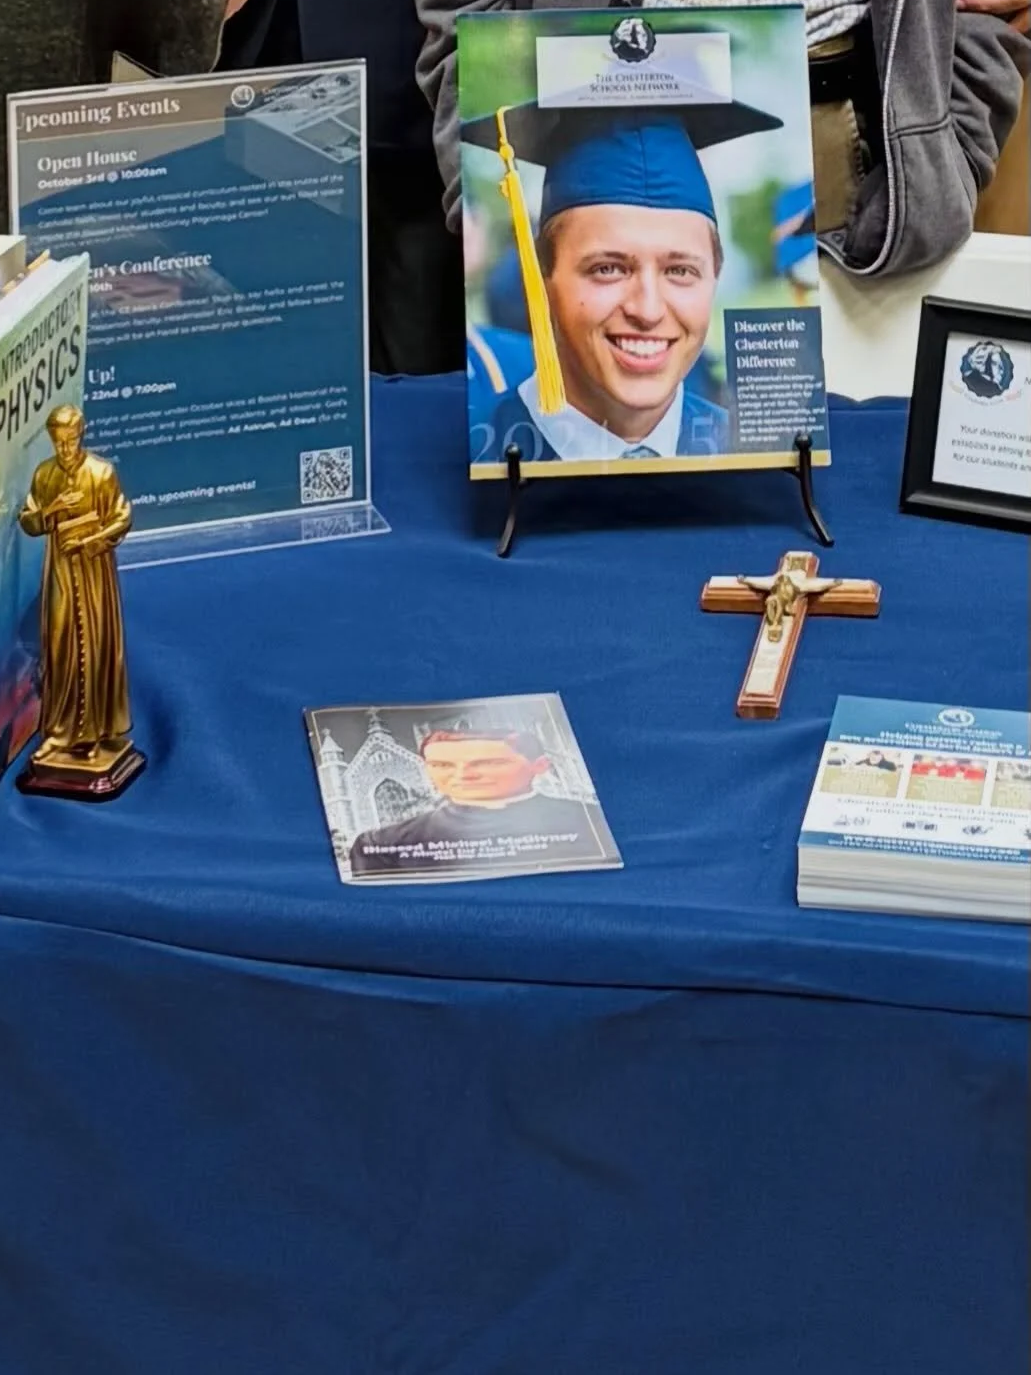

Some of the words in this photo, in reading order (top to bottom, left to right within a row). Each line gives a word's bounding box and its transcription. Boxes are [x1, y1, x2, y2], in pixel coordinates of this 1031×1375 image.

[117, 98, 181, 119] Events
[37, 156, 82, 173] Open
[86, 150, 137, 167] House
[38, 176, 83, 190] October
[86, 173, 104, 184] 3rd
[121, 167, 168, 180] 10:00am
[120, 254, 212, 275] Conference
[734, 321, 786, 333] Discover
[787, 319, 806, 332] the
[735, 338, 799, 351] Chesterton
[736, 355, 797, 369] Difference
[88, 366, 115, 385] Up!
[91, 388, 119, 401] 22nd
[134, 382, 177, 394] 7:00pm
[960, 424, 978, 435] Your
[158, 487, 215, 503] upcoming
[216, 480, 256, 494] events!
